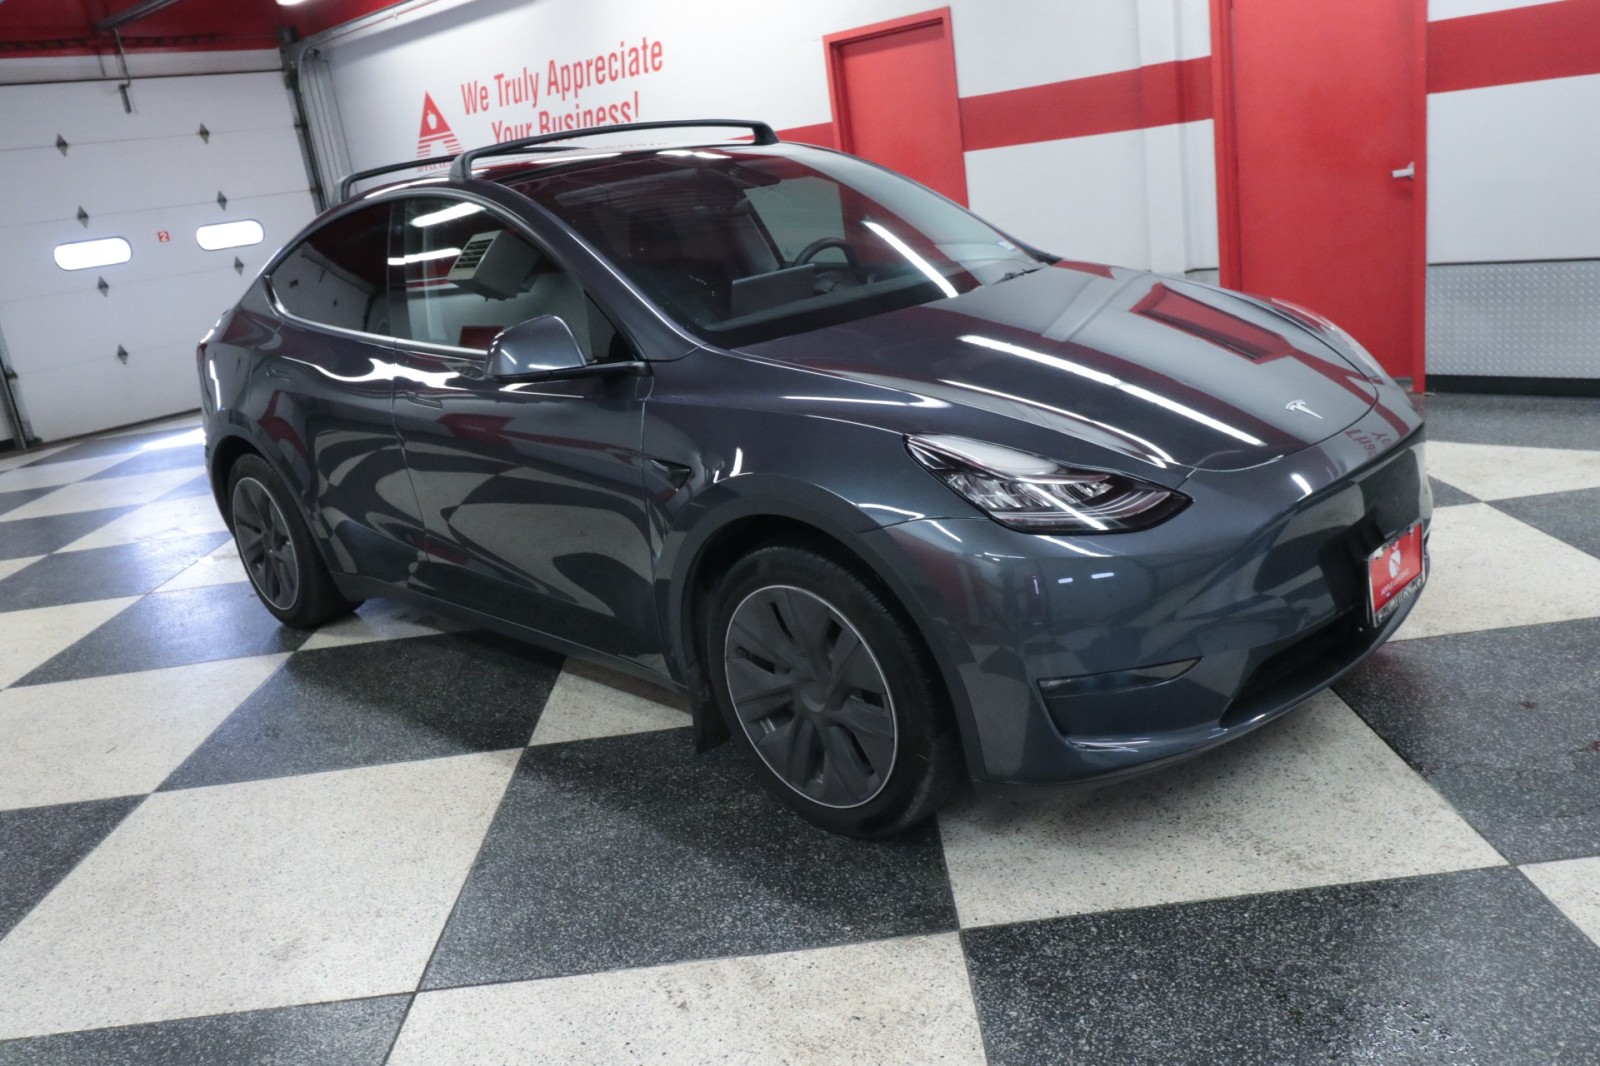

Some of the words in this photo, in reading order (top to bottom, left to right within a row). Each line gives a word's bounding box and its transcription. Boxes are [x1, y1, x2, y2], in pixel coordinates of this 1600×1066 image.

[461, 80, 489, 115] We
[494, 67, 539, 108] Truly
[547, 37, 663, 101] Appreciate
[491, 120, 532, 144] Your
